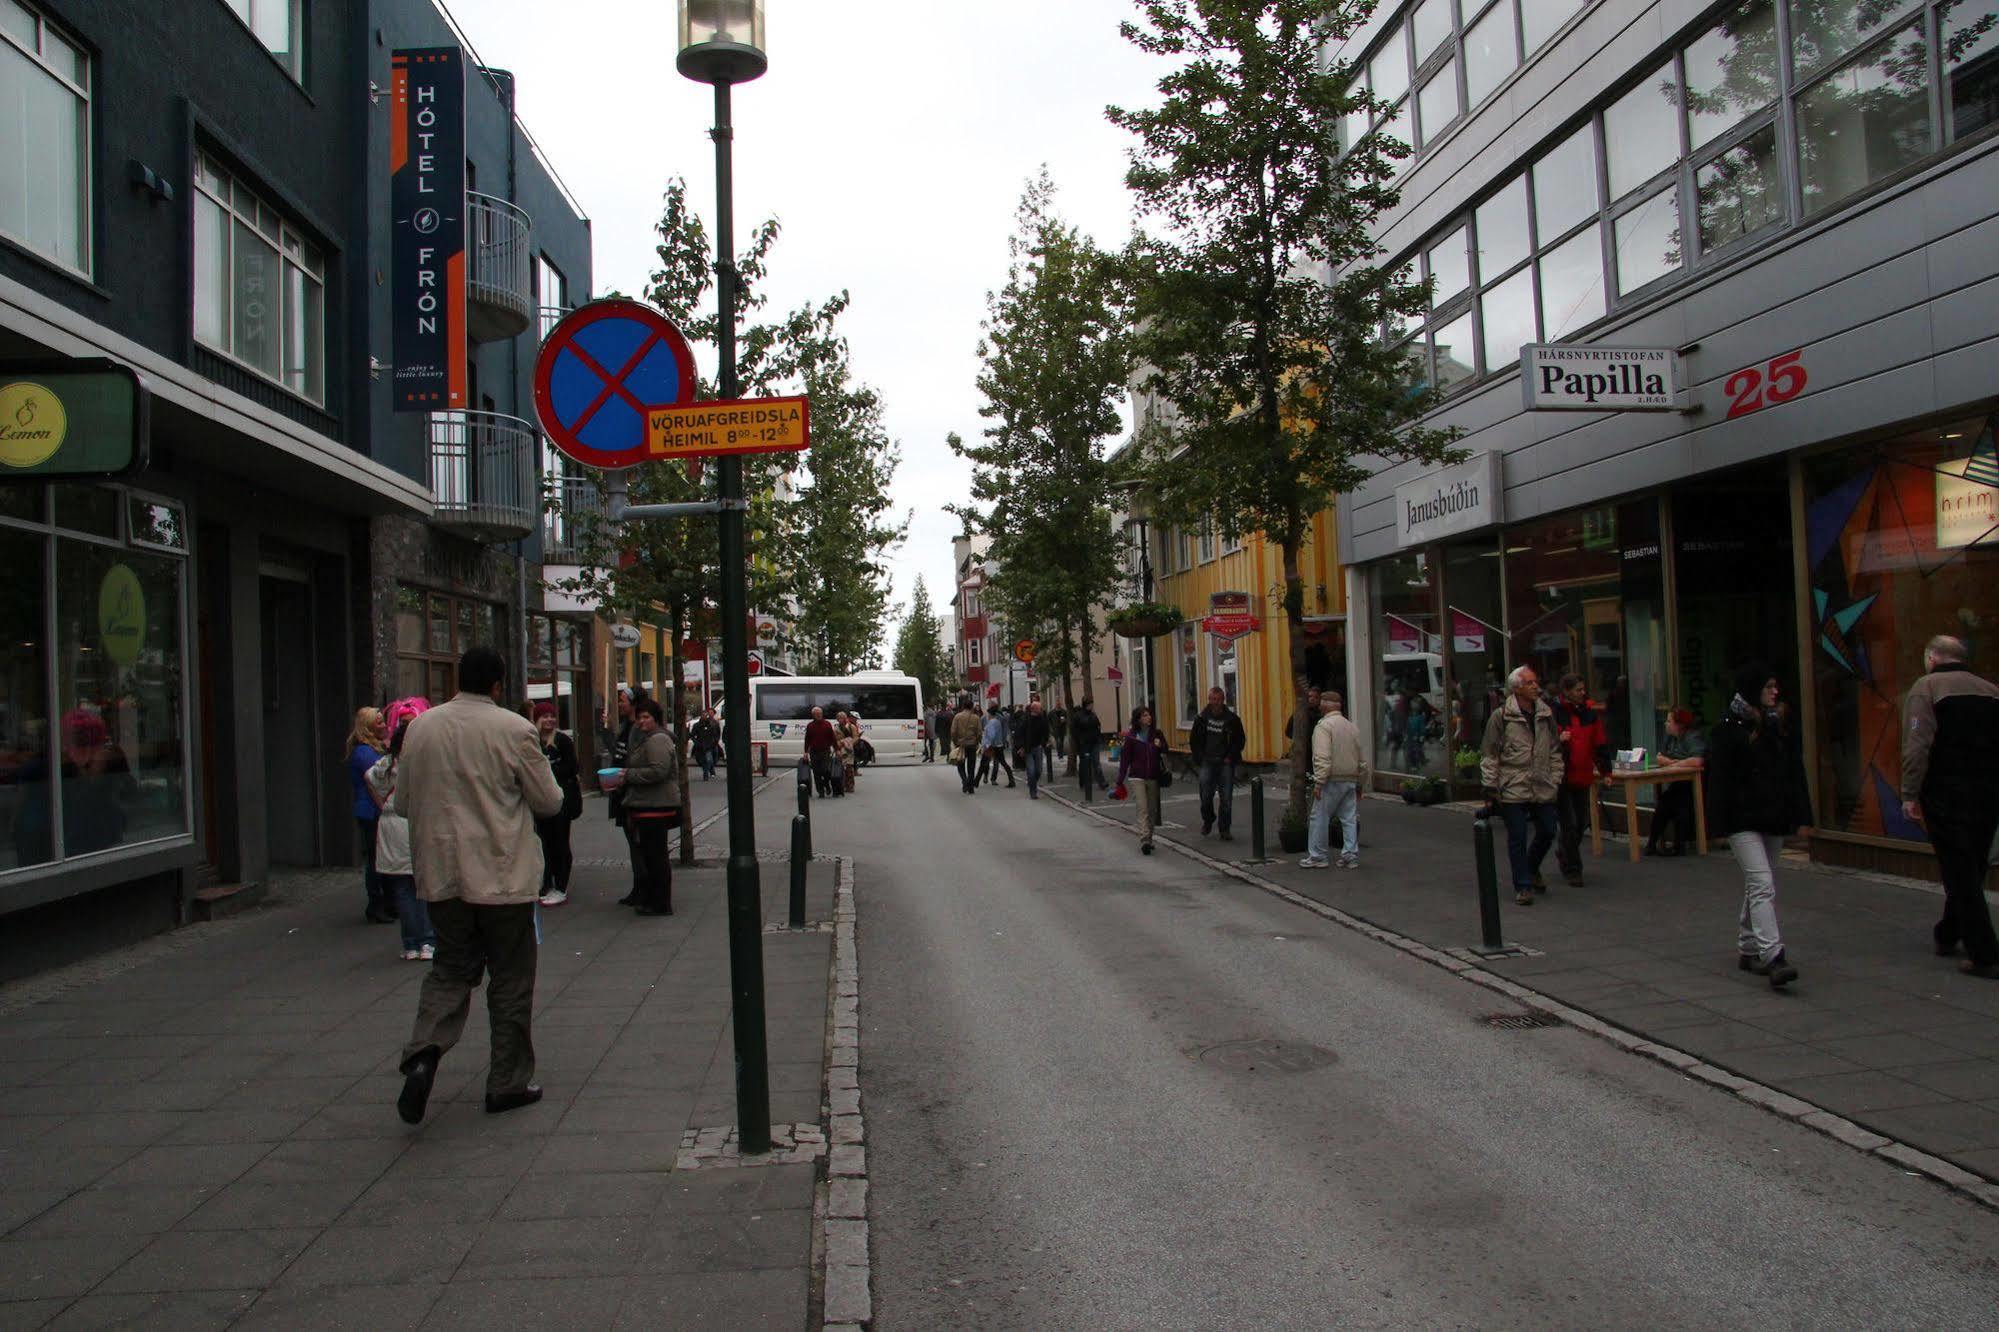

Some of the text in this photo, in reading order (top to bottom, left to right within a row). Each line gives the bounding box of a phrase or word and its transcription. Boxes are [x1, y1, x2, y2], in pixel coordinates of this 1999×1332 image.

[416, 85, 435, 193] HÓTEL
[417, 247, 437, 334] FRÓN
[1538, 348, 1664, 361] HÁRSNYRTISTOFAN
[1539, 363, 1667, 403] Papilla
[1723, 350, 1808, 421] 25
[0, 425, 51, 440] Lemon
[663, 431, 719, 449] HEIMIL
[1406, 480, 1479, 534] Janusbúðin
[1623, 545, 1659, 560] SEBASTIAN
